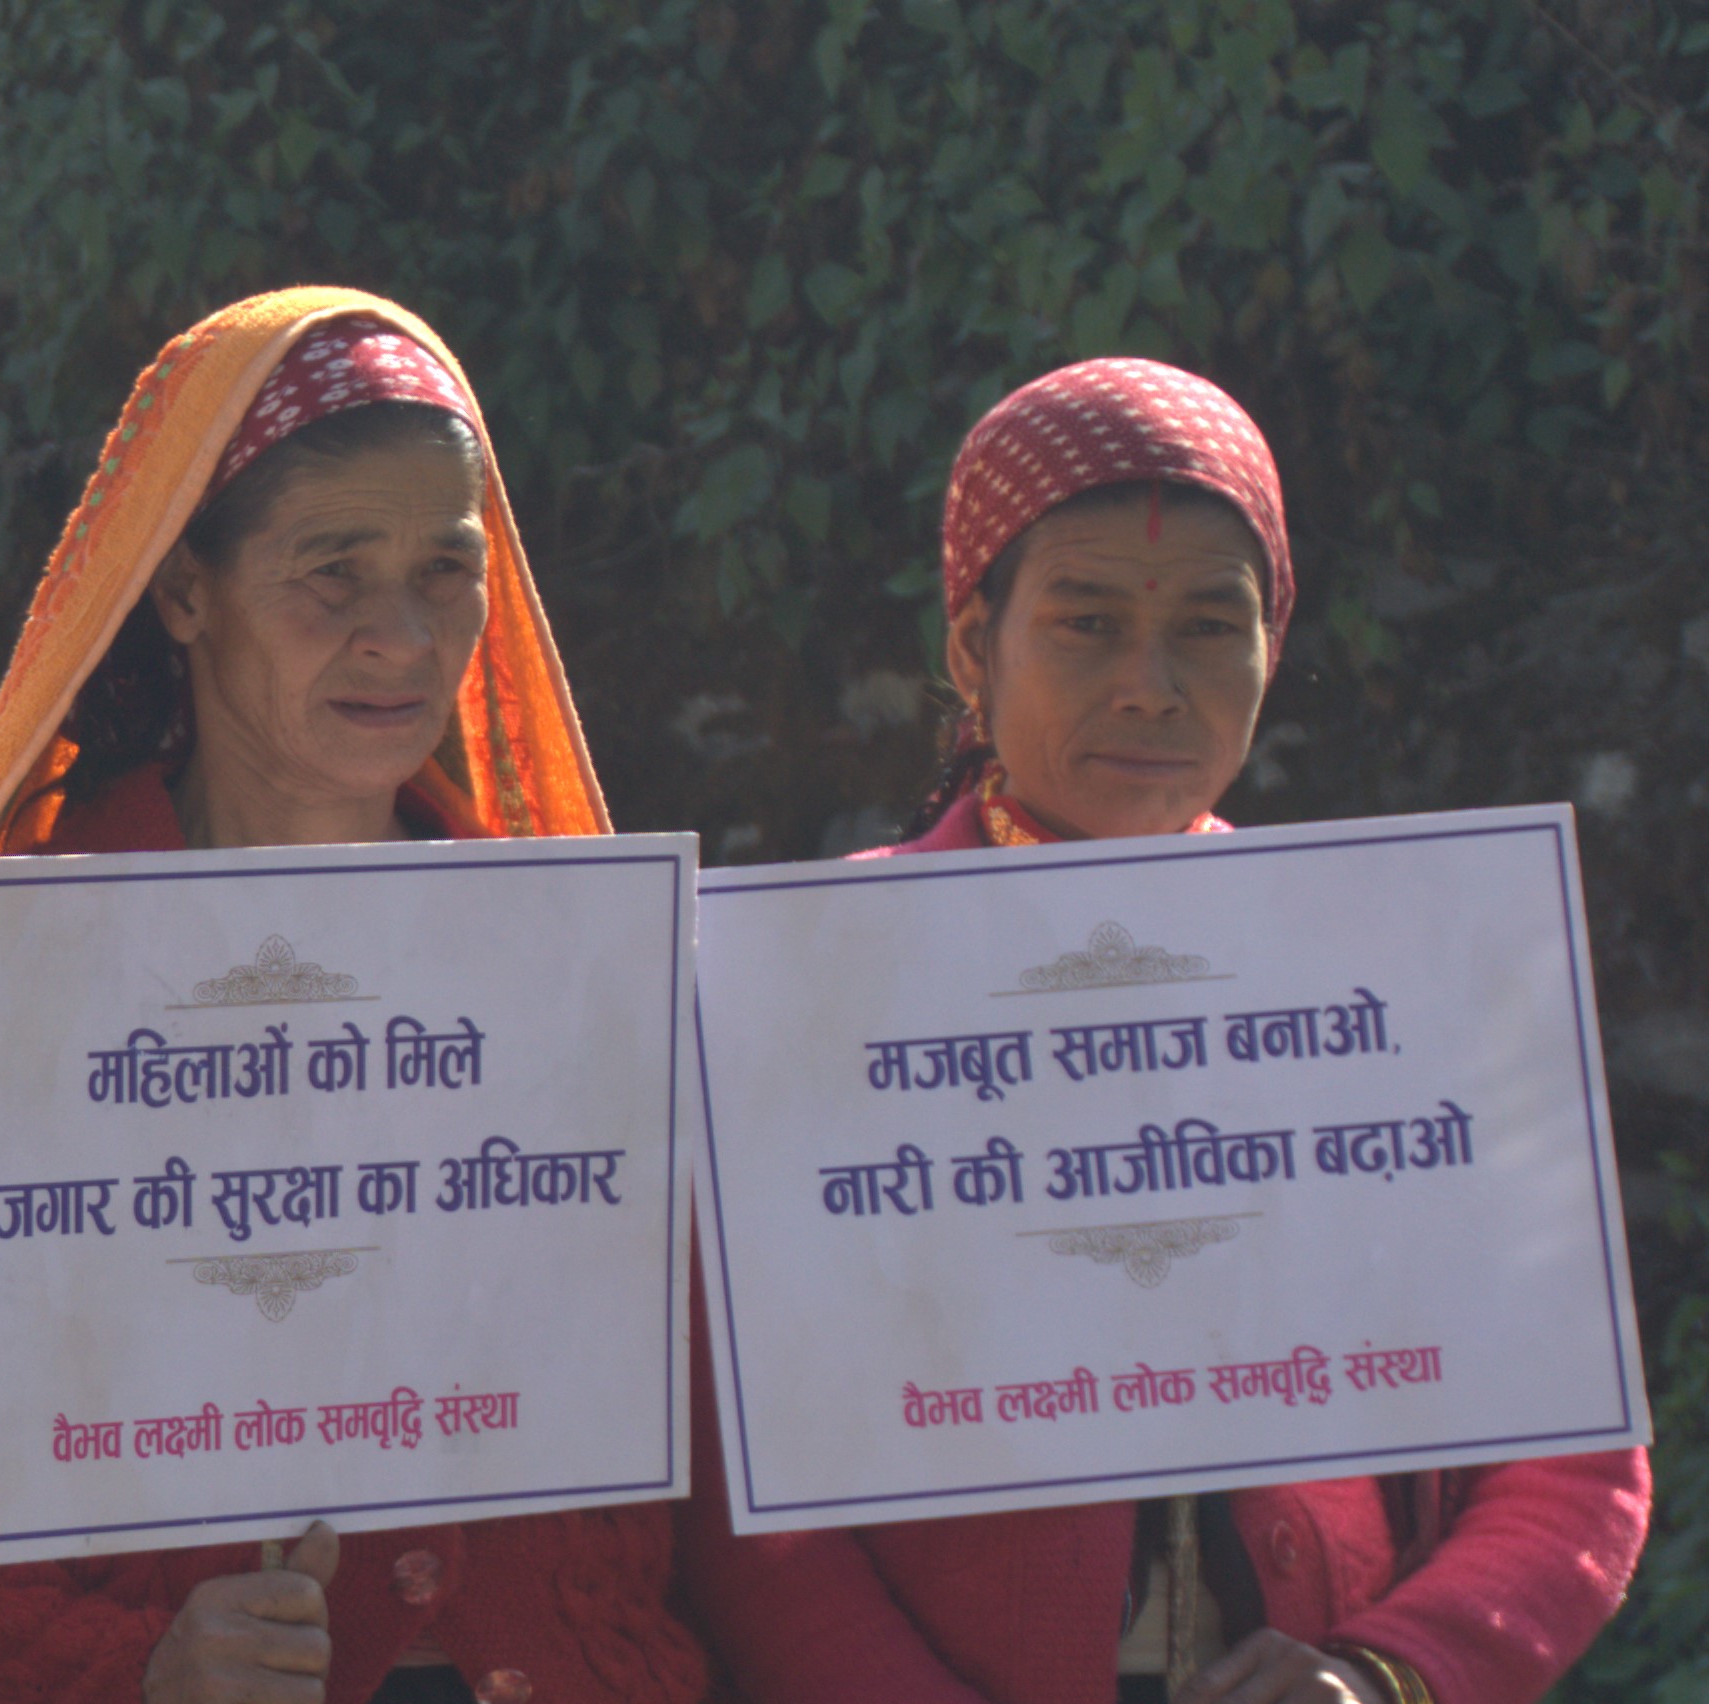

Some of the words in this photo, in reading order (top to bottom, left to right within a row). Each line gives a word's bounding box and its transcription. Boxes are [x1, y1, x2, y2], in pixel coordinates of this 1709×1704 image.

[87, 1022, 294, 1109] महिलाओं
[307, 1021, 371, 1093] को
[384, 1015, 486, 1090] मिले
[864, 1030, 1033, 1102] मजबूत
[1048, 1016, 1208, 1082] समाज
[1223, 986, 1401, 1063] बनाओ,
[132, 1155, 197, 1230] की
[210, 1165, 343, 1243] सुरक्षा
[357, 1160, 420, 1216] का
[435, 1135, 626, 1213] अधिकार
[818, 1143, 934, 1217] नारी
[950, 1135, 1024, 1207] की
[1045, 1117, 1296, 1201] आजीविका
[1312, 1099, 1473, 1182] बढ़ाओ
[52, 1412, 124, 1463] वैभव
[133, 1401, 224, 1460] लक्ष्मी
[233, 1398, 308, 1452] लोक
[434, 1384, 520, 1437] संस्था
[901, 1381, 984, 1429] वैभव
[994, 1365, 1100, 1424] लक्ष्मी
[1110, 1361, 1196, 1413] लोक
[1343, 1340, 1443, 1392] संस्था
